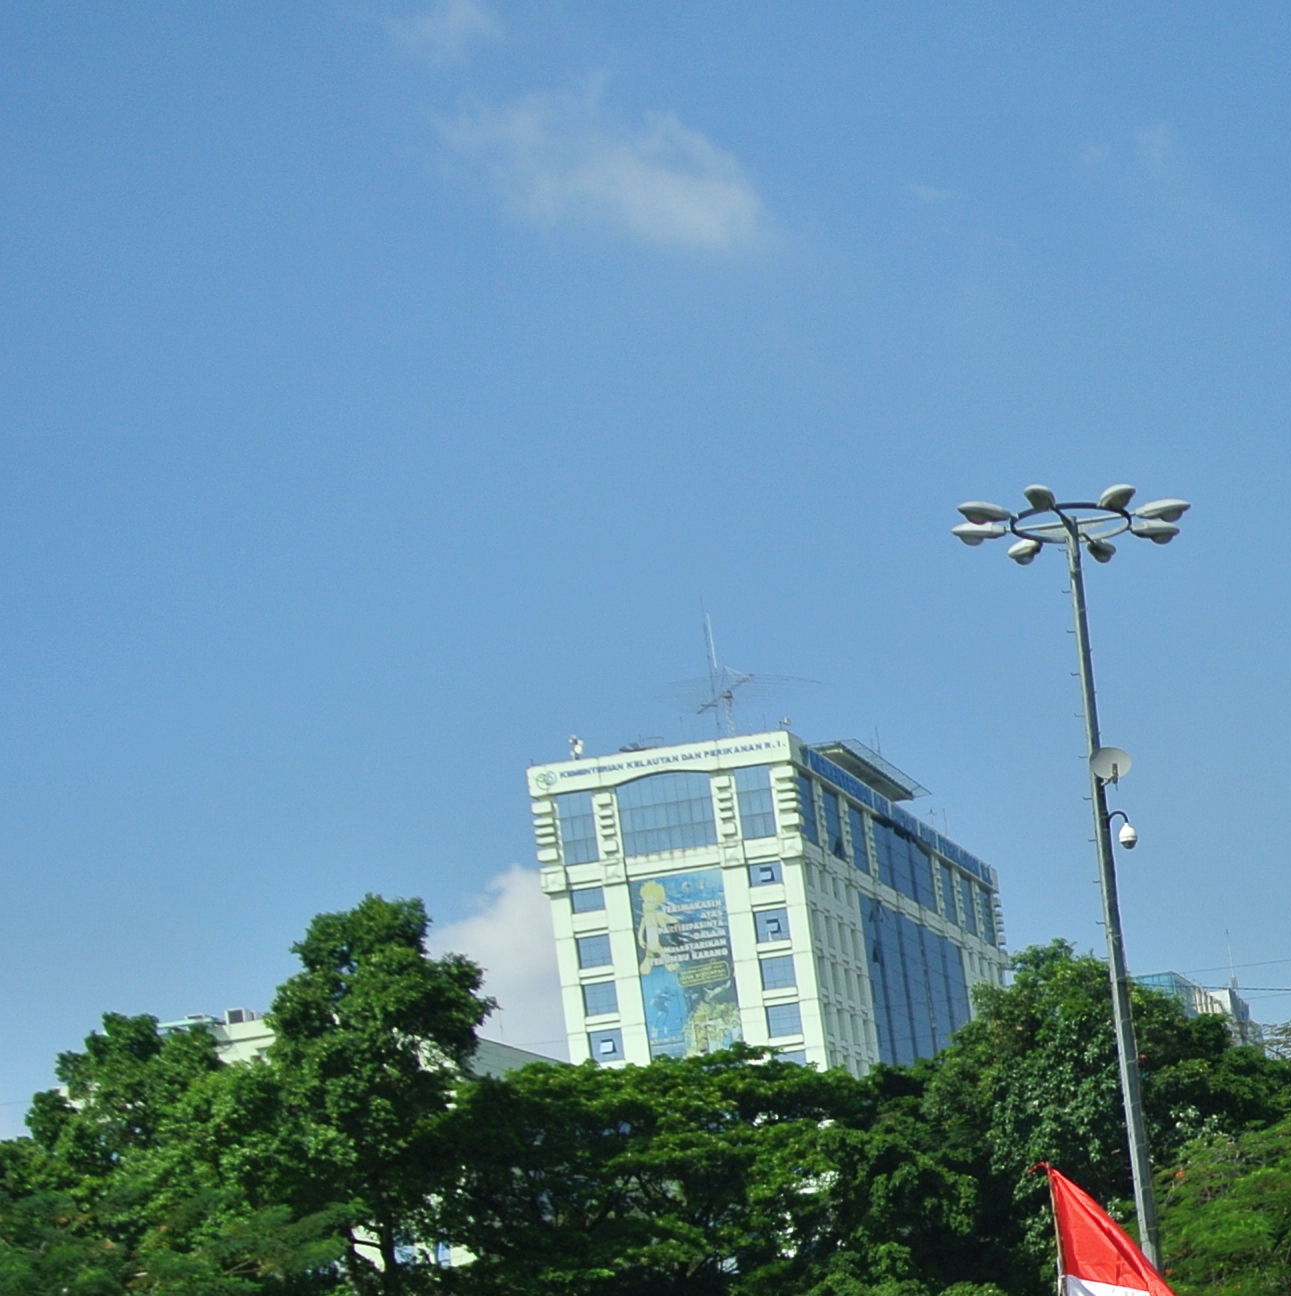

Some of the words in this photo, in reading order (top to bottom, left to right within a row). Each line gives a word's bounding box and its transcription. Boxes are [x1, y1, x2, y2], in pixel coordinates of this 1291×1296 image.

[559, 763, 624, 779] KEMENTERIAN
[626, 756, 679, 770] KELAUTAN
[681, 752, 702, 762] DAN
[704, 744, 763, 759] PERIKANAN
